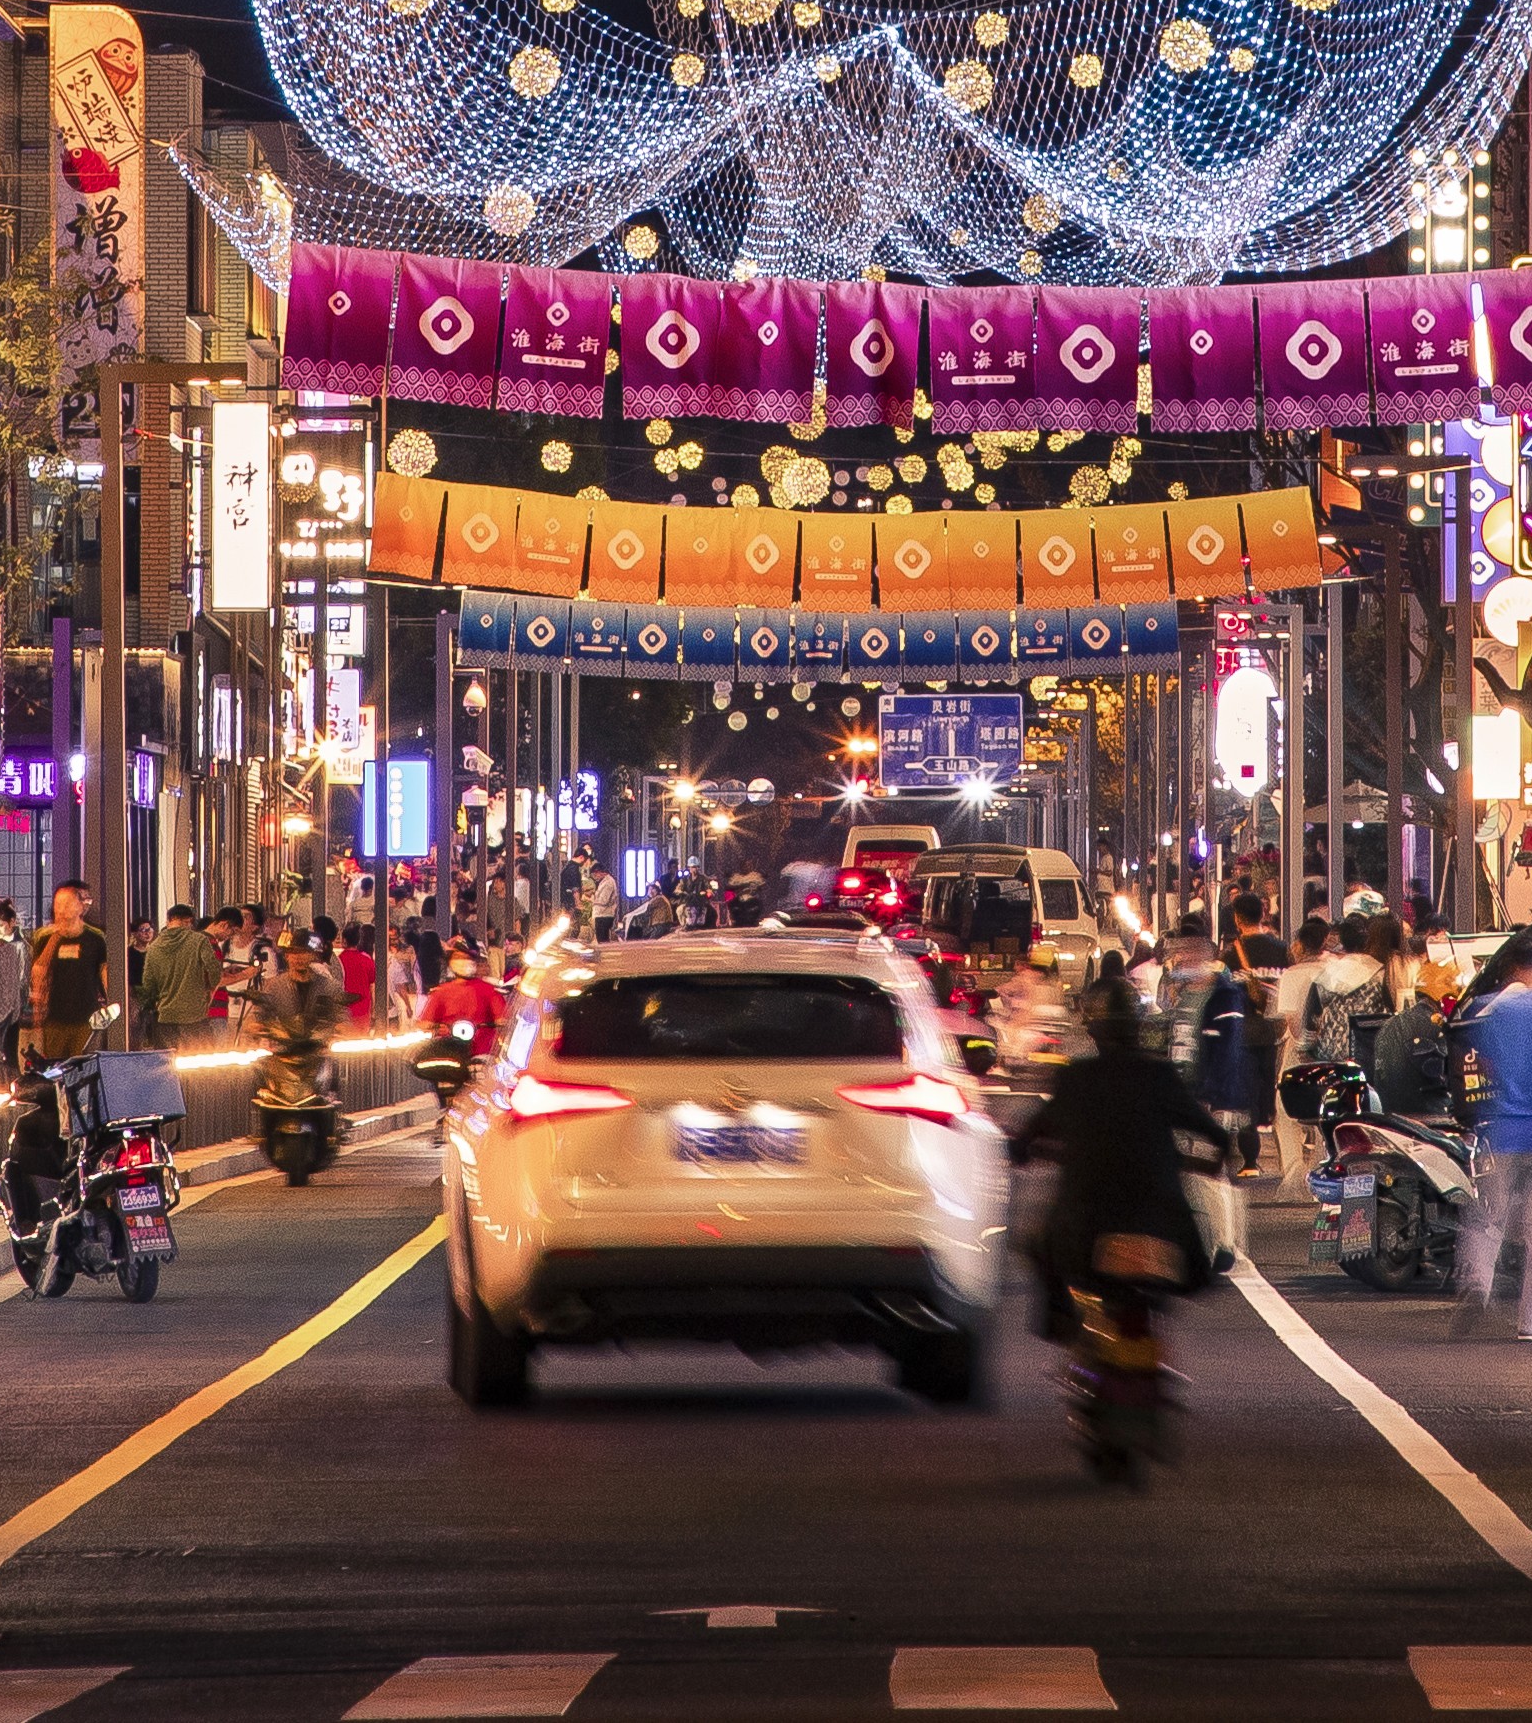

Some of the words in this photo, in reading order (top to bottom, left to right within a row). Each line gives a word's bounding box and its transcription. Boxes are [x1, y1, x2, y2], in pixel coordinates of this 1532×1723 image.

[511, 328, 600, 355] 淮海街
[1380, 338, 1470, 362] 淮海街
[938, 350, 1027, 371] 淮海街
[521, 535, 580, 555] 淮海街
[1102, 546, 1161, 563] 淮海街
[807, 555, 866, 571] 淮海街
[934, 760, 969, 771] 玉山路
